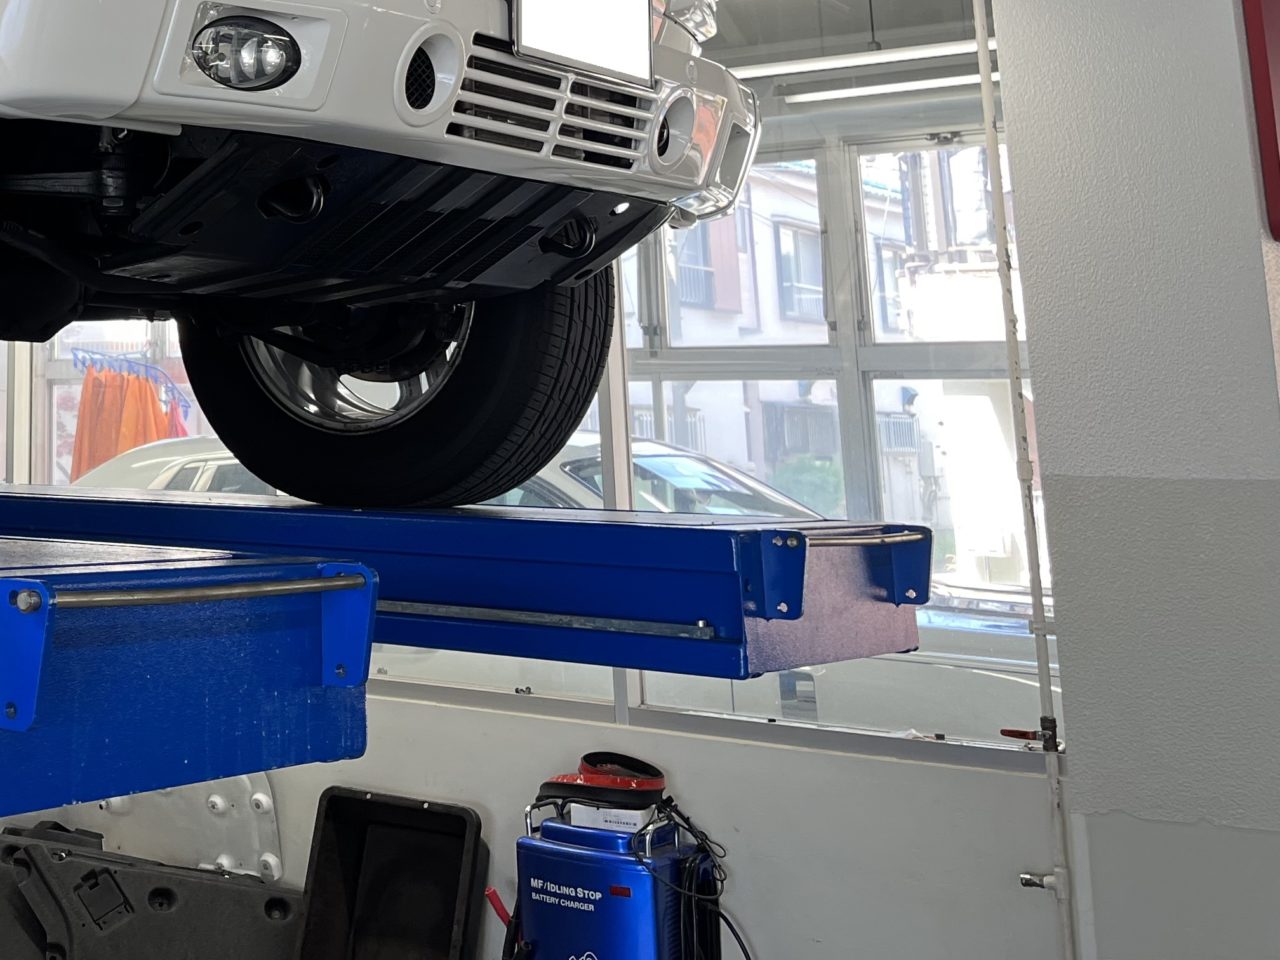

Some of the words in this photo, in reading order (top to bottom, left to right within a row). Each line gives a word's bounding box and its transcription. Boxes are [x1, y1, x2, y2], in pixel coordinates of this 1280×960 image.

[531, 892, 559, 905] BATTERY
[560, 899, 594, 912] CHARGER
[576, 887, 602, 901] STOP
